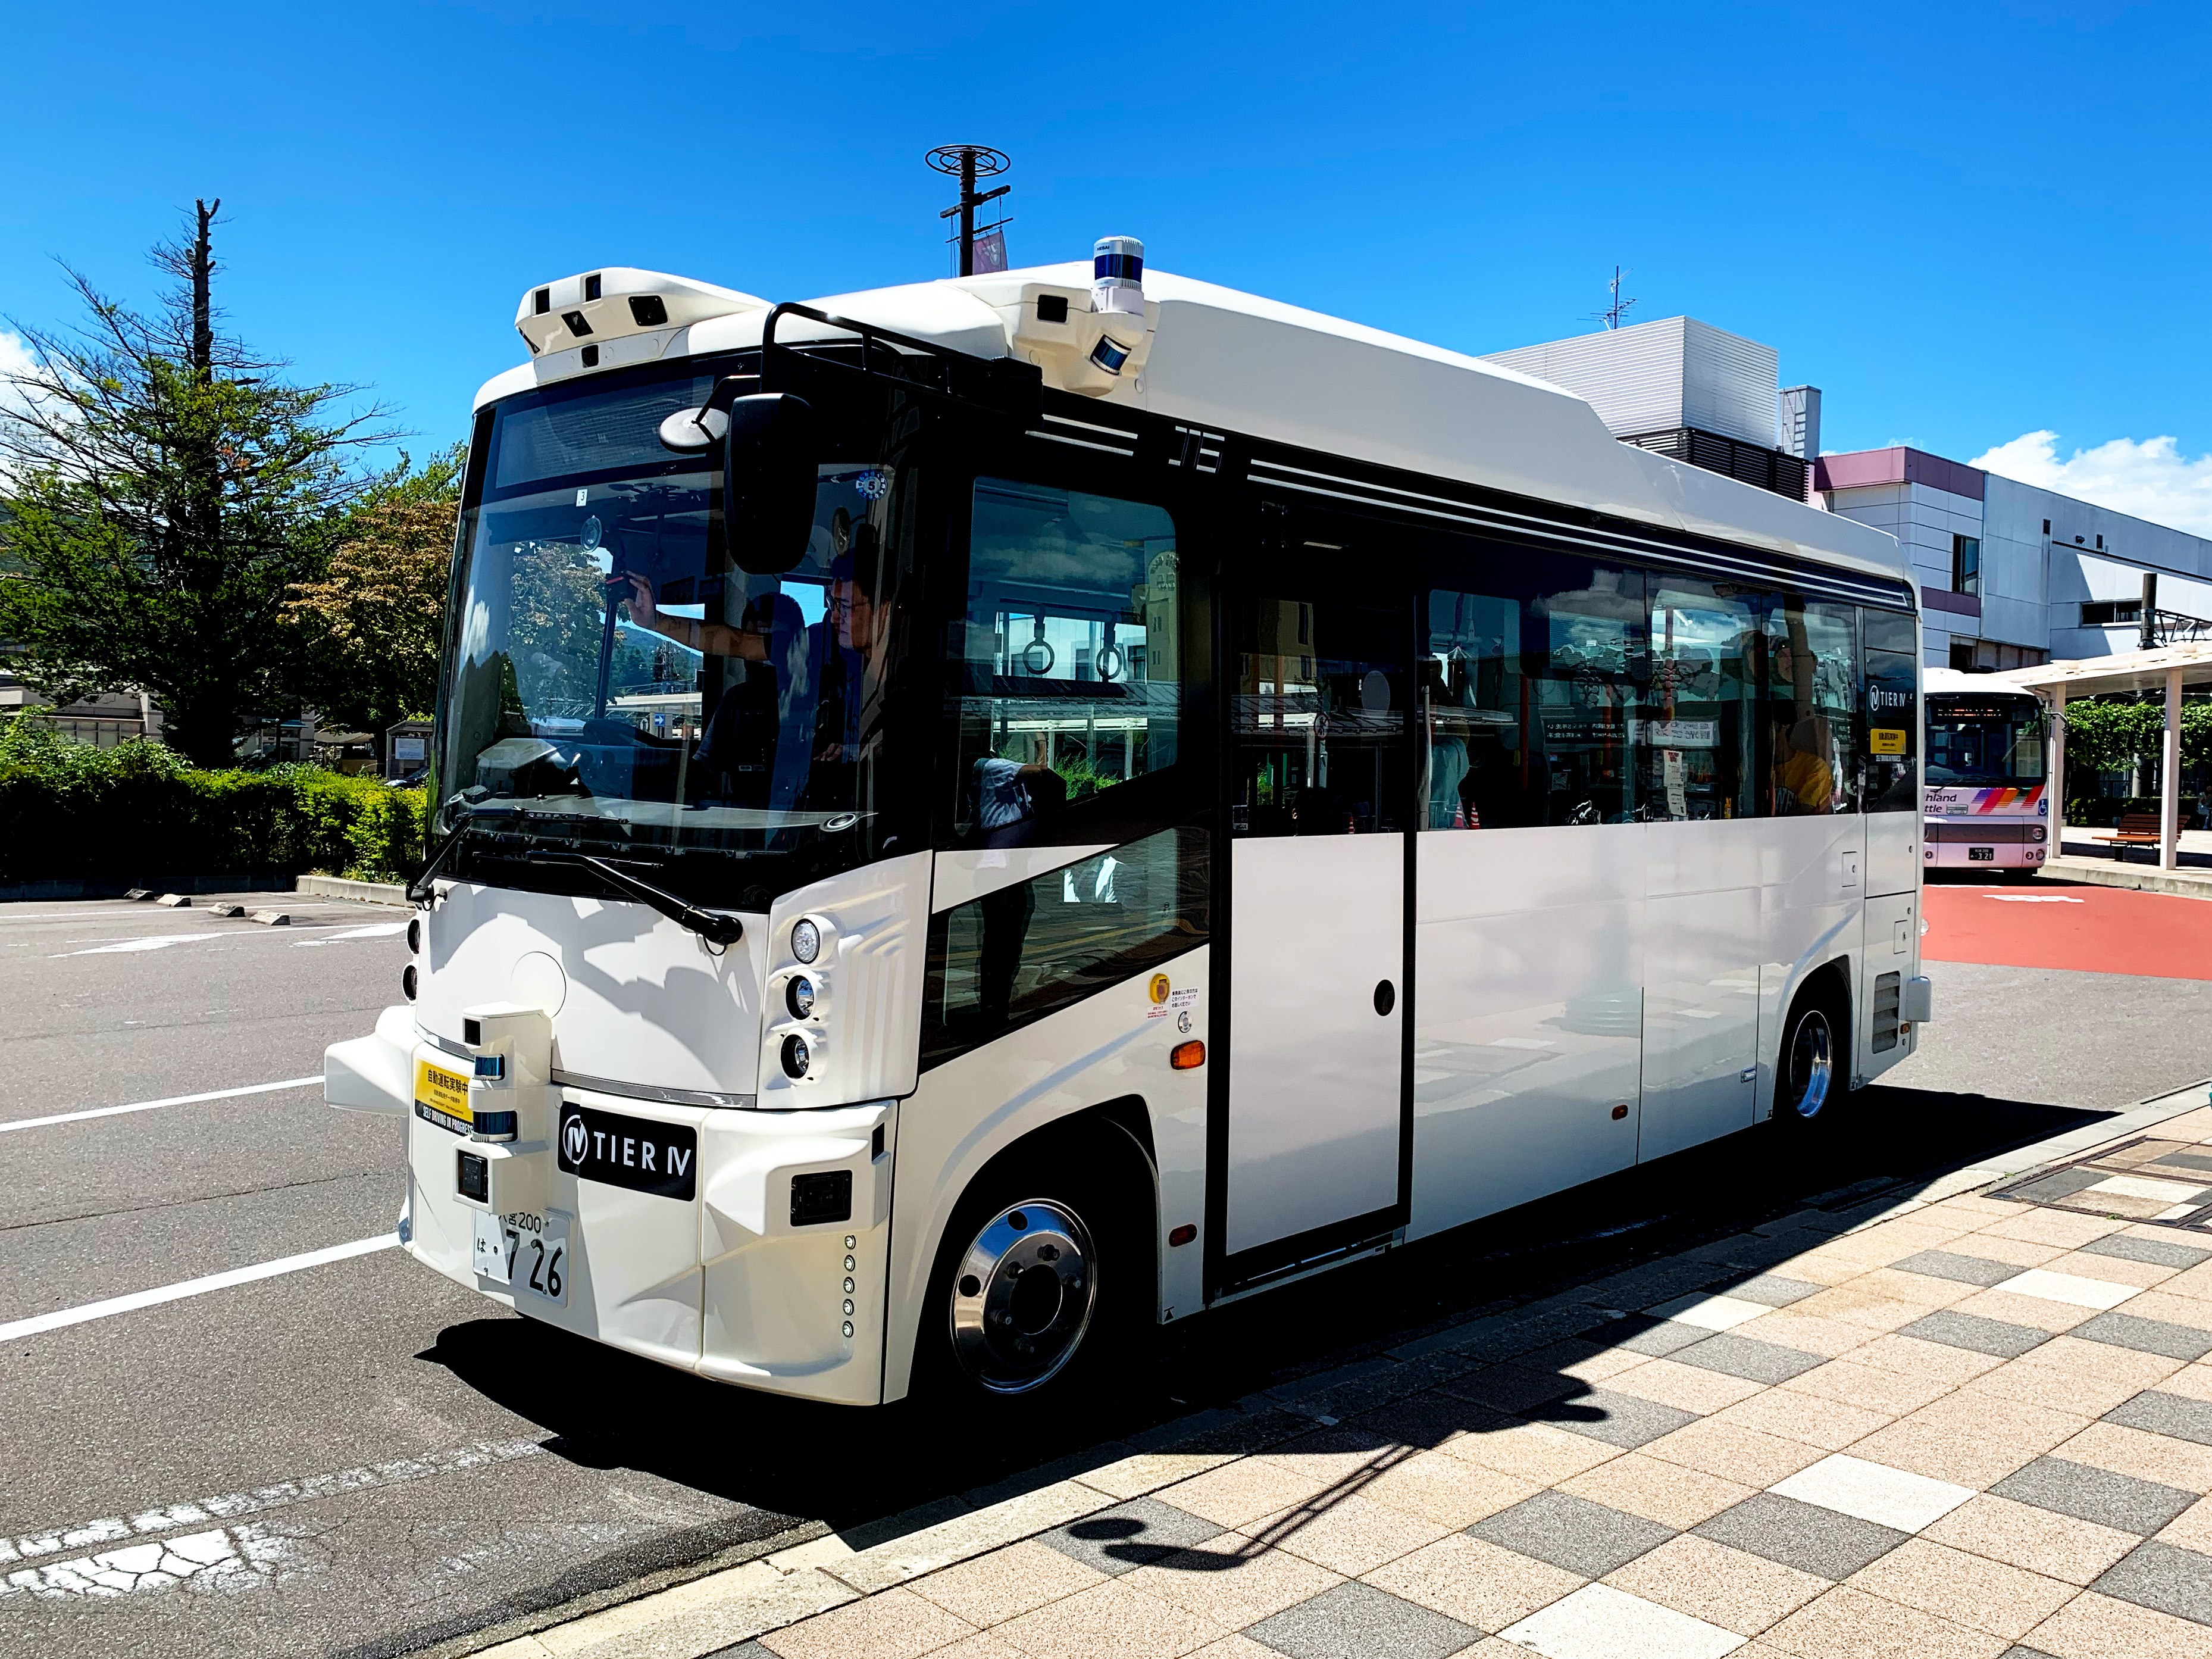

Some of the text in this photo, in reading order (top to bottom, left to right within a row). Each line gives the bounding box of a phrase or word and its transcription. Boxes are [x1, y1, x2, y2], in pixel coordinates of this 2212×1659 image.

[868, 481, 875, 490] 5
[581, 491, 585, 501] 3
[1880, 691, 1898, 707] TIER
[428, 1069, 468, 1095] 自動運転実験中
[423, 1105, 431, 1120] SELF
[431, 1109, 446, 1126] DRIVING
[594, 1131, 691, 1176] TIER IV
[519, 1212, 542, 1234] 200
[477, 1236, 486, 1254] は
